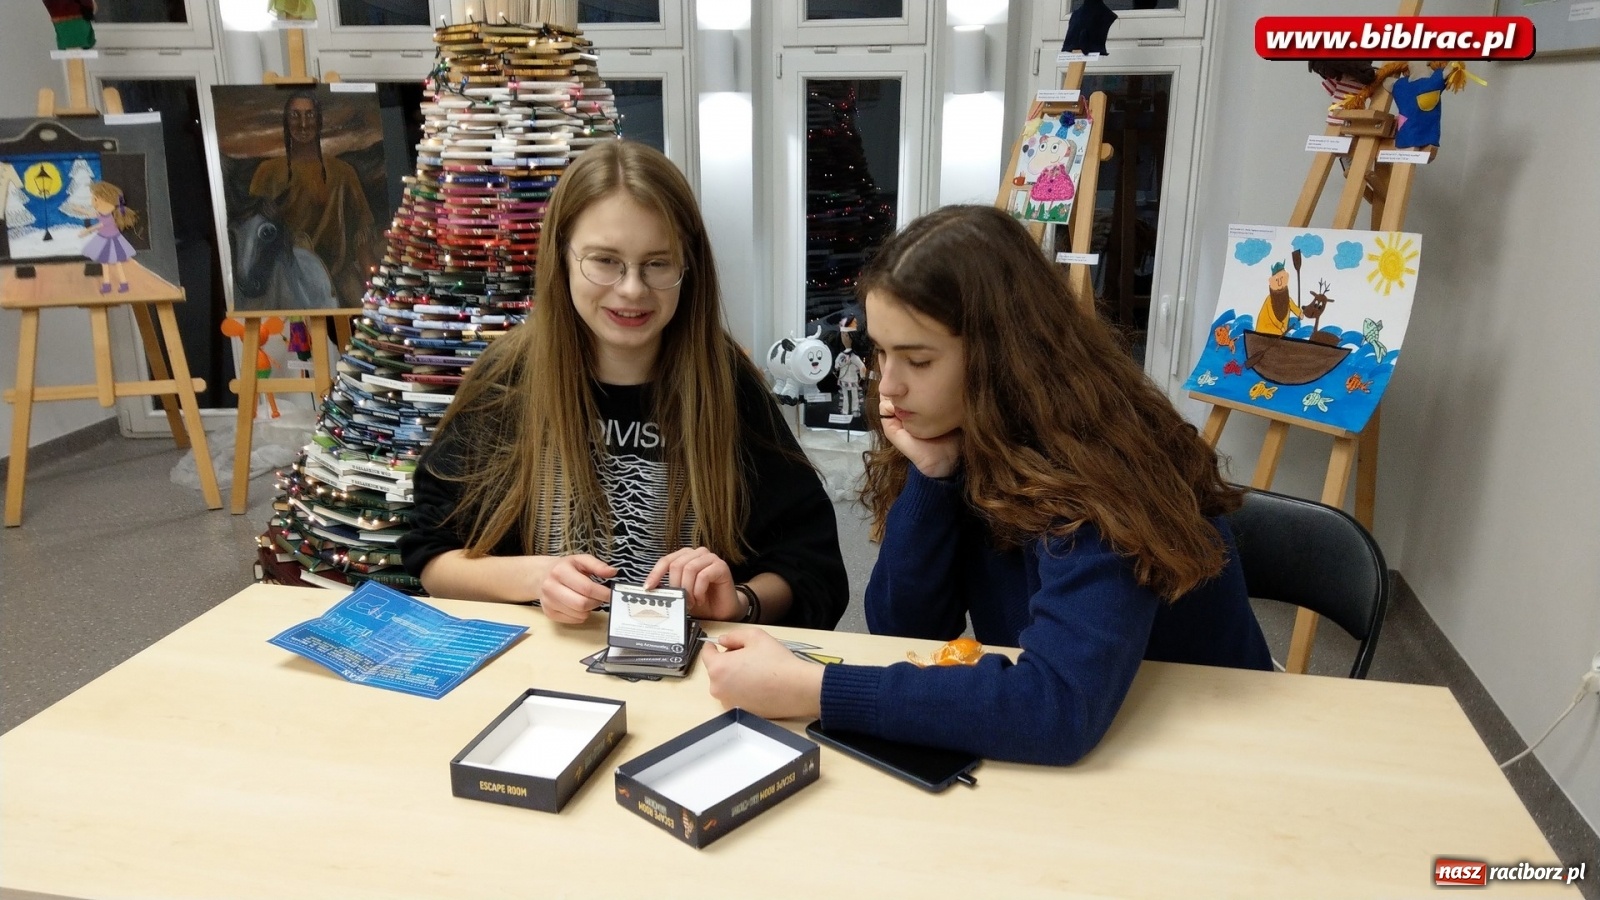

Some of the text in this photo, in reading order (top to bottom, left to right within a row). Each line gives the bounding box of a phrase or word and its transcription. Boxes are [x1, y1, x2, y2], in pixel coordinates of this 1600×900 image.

[479, 780, 527, 797] ESCAPE ROOM
[760, 771, 796, 801] ESCAPE ROOM
[638, 800, 654, 818] ROOM
[654, 809, 675, 829] ESCAPE
